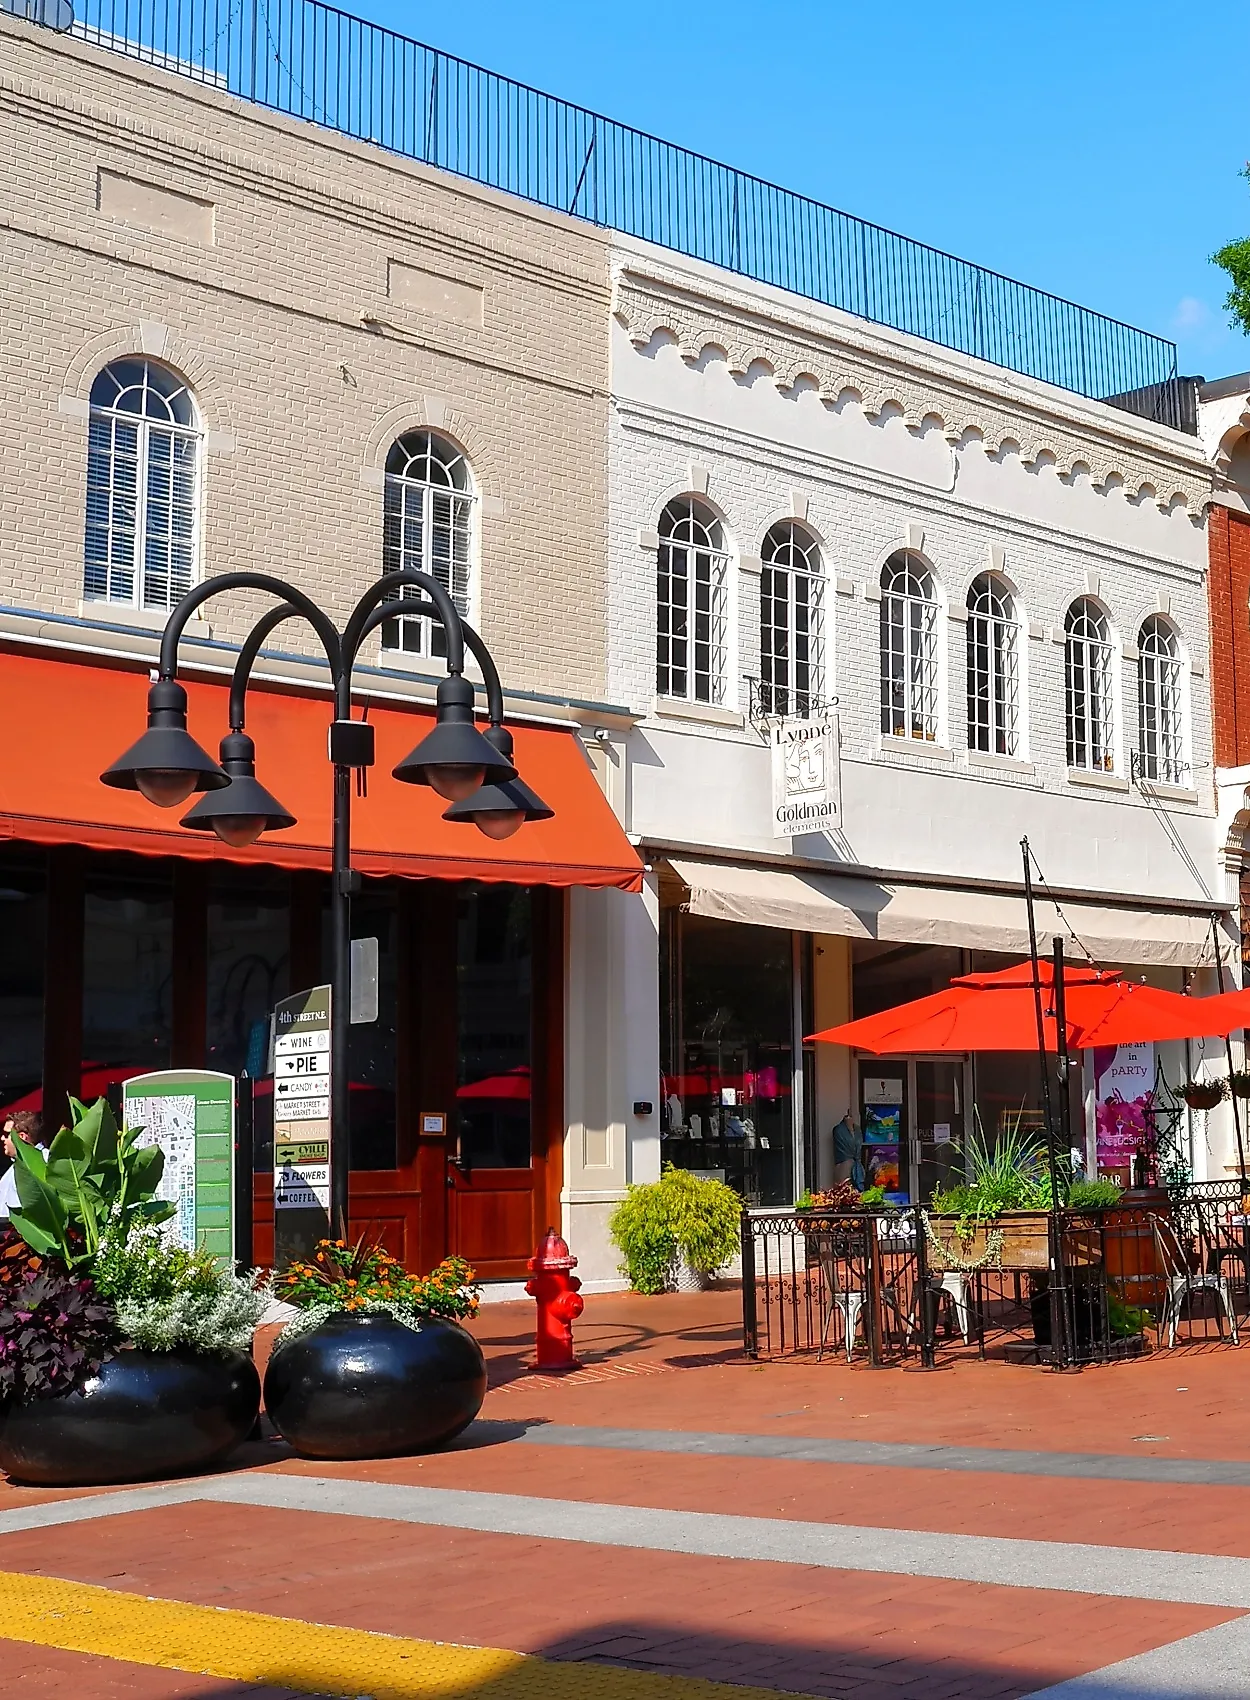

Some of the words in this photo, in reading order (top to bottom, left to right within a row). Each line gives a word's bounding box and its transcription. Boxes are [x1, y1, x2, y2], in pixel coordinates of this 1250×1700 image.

[776, 723, 832, 748] Lynne
[776, 801, 837, 822] Goldman
[783, 820, 831, 834] elements
[279, 1010, 293, 1024] 4th
[293, 1012, 315, 1023] STREET
[290, 1036, 313, 1048] WINE
[1128, 1052, 1138, 1061] in
[296, 1056, 317, 1073] PIE
[1111, 1066, 1148, 1078] pARTy
[290, 1082, 313, 1093] CANDY
[298, 1144, 327, 1154] CVILLE
[291, 1170, 326, 1181] FLOWERS
[289, 1193, 316, 1203] COFFEE
